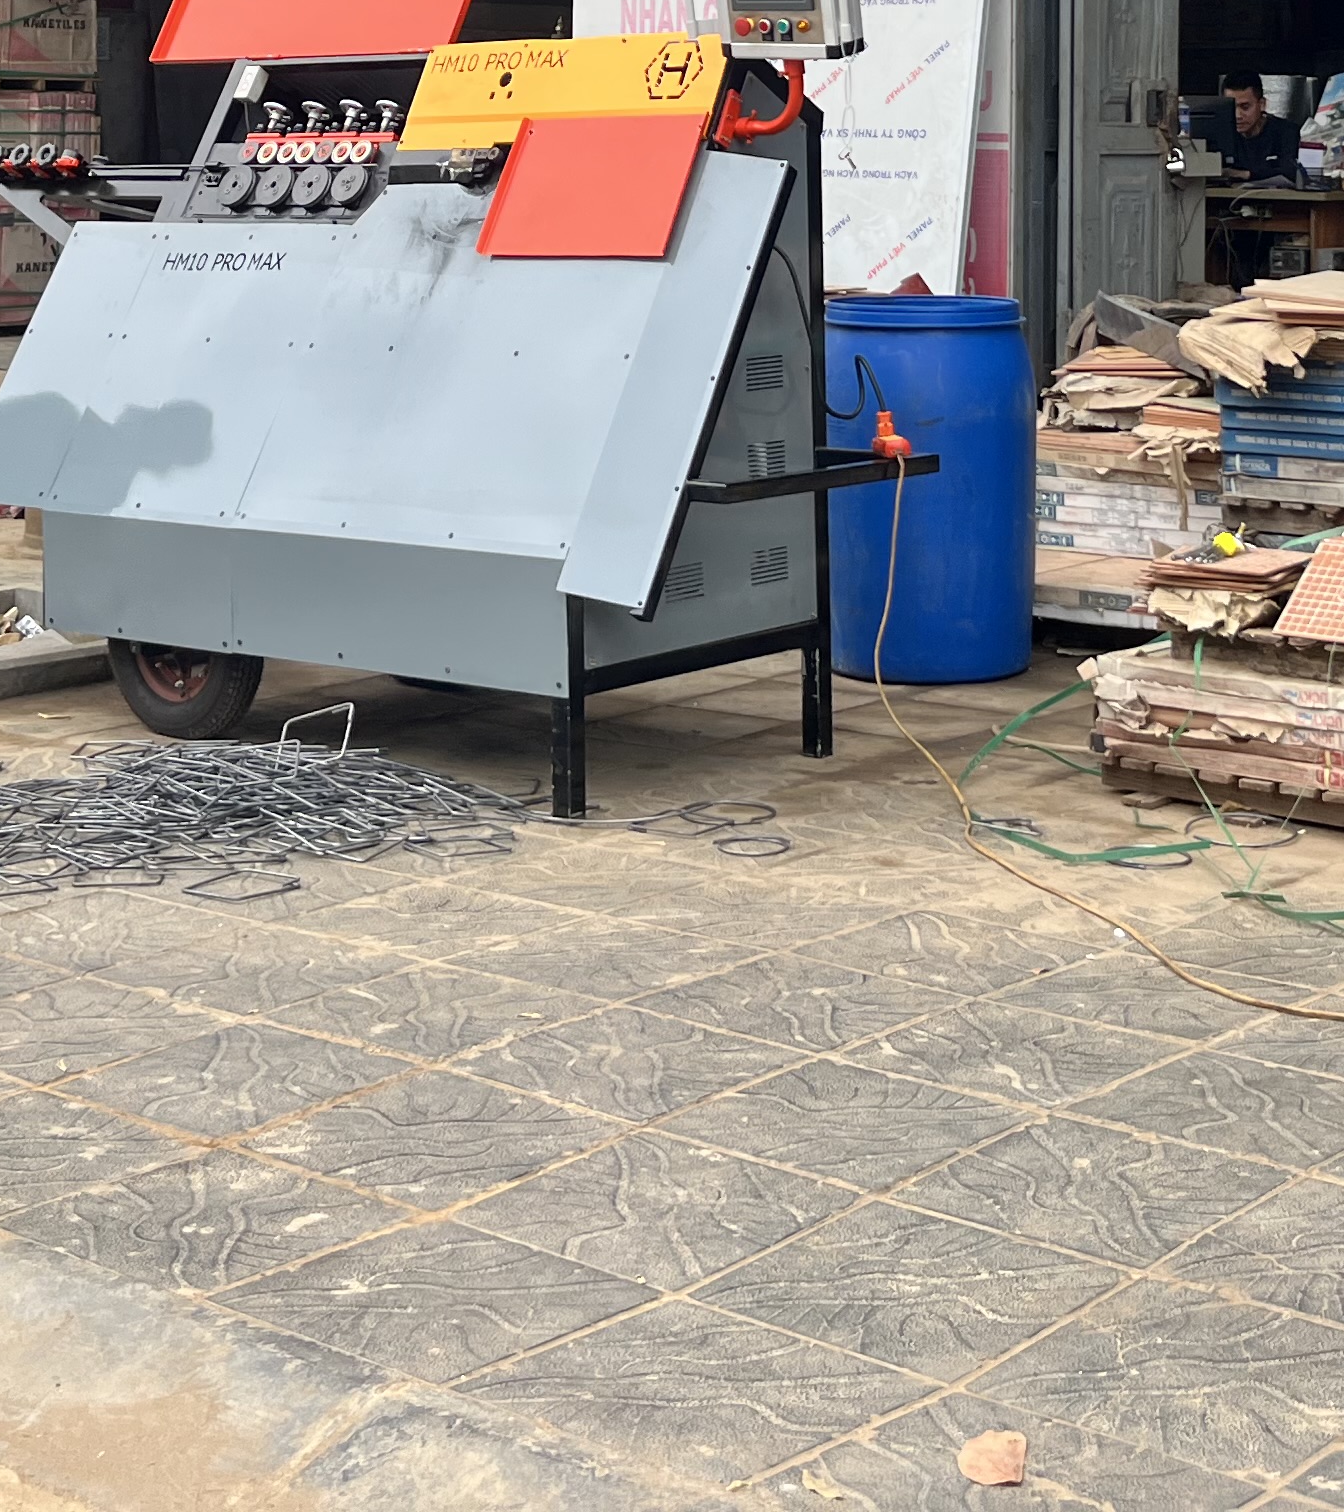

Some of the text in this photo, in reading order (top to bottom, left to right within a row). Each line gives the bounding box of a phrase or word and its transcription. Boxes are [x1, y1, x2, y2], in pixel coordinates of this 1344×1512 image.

[23, 15, 86, 30] KANETILES
[431, 49, 569, 73] HM10 PRO MAX
[924, 40, 950, 65] PANEL
[836, 128, 848, 137] SX
[898, 128, 926, 140] CÔNG
[825, 214, 851, 238] PANEL
[906, 217, 934, 241] PANEL
[162, 252, 287, 271] HM10 PRO MAX
